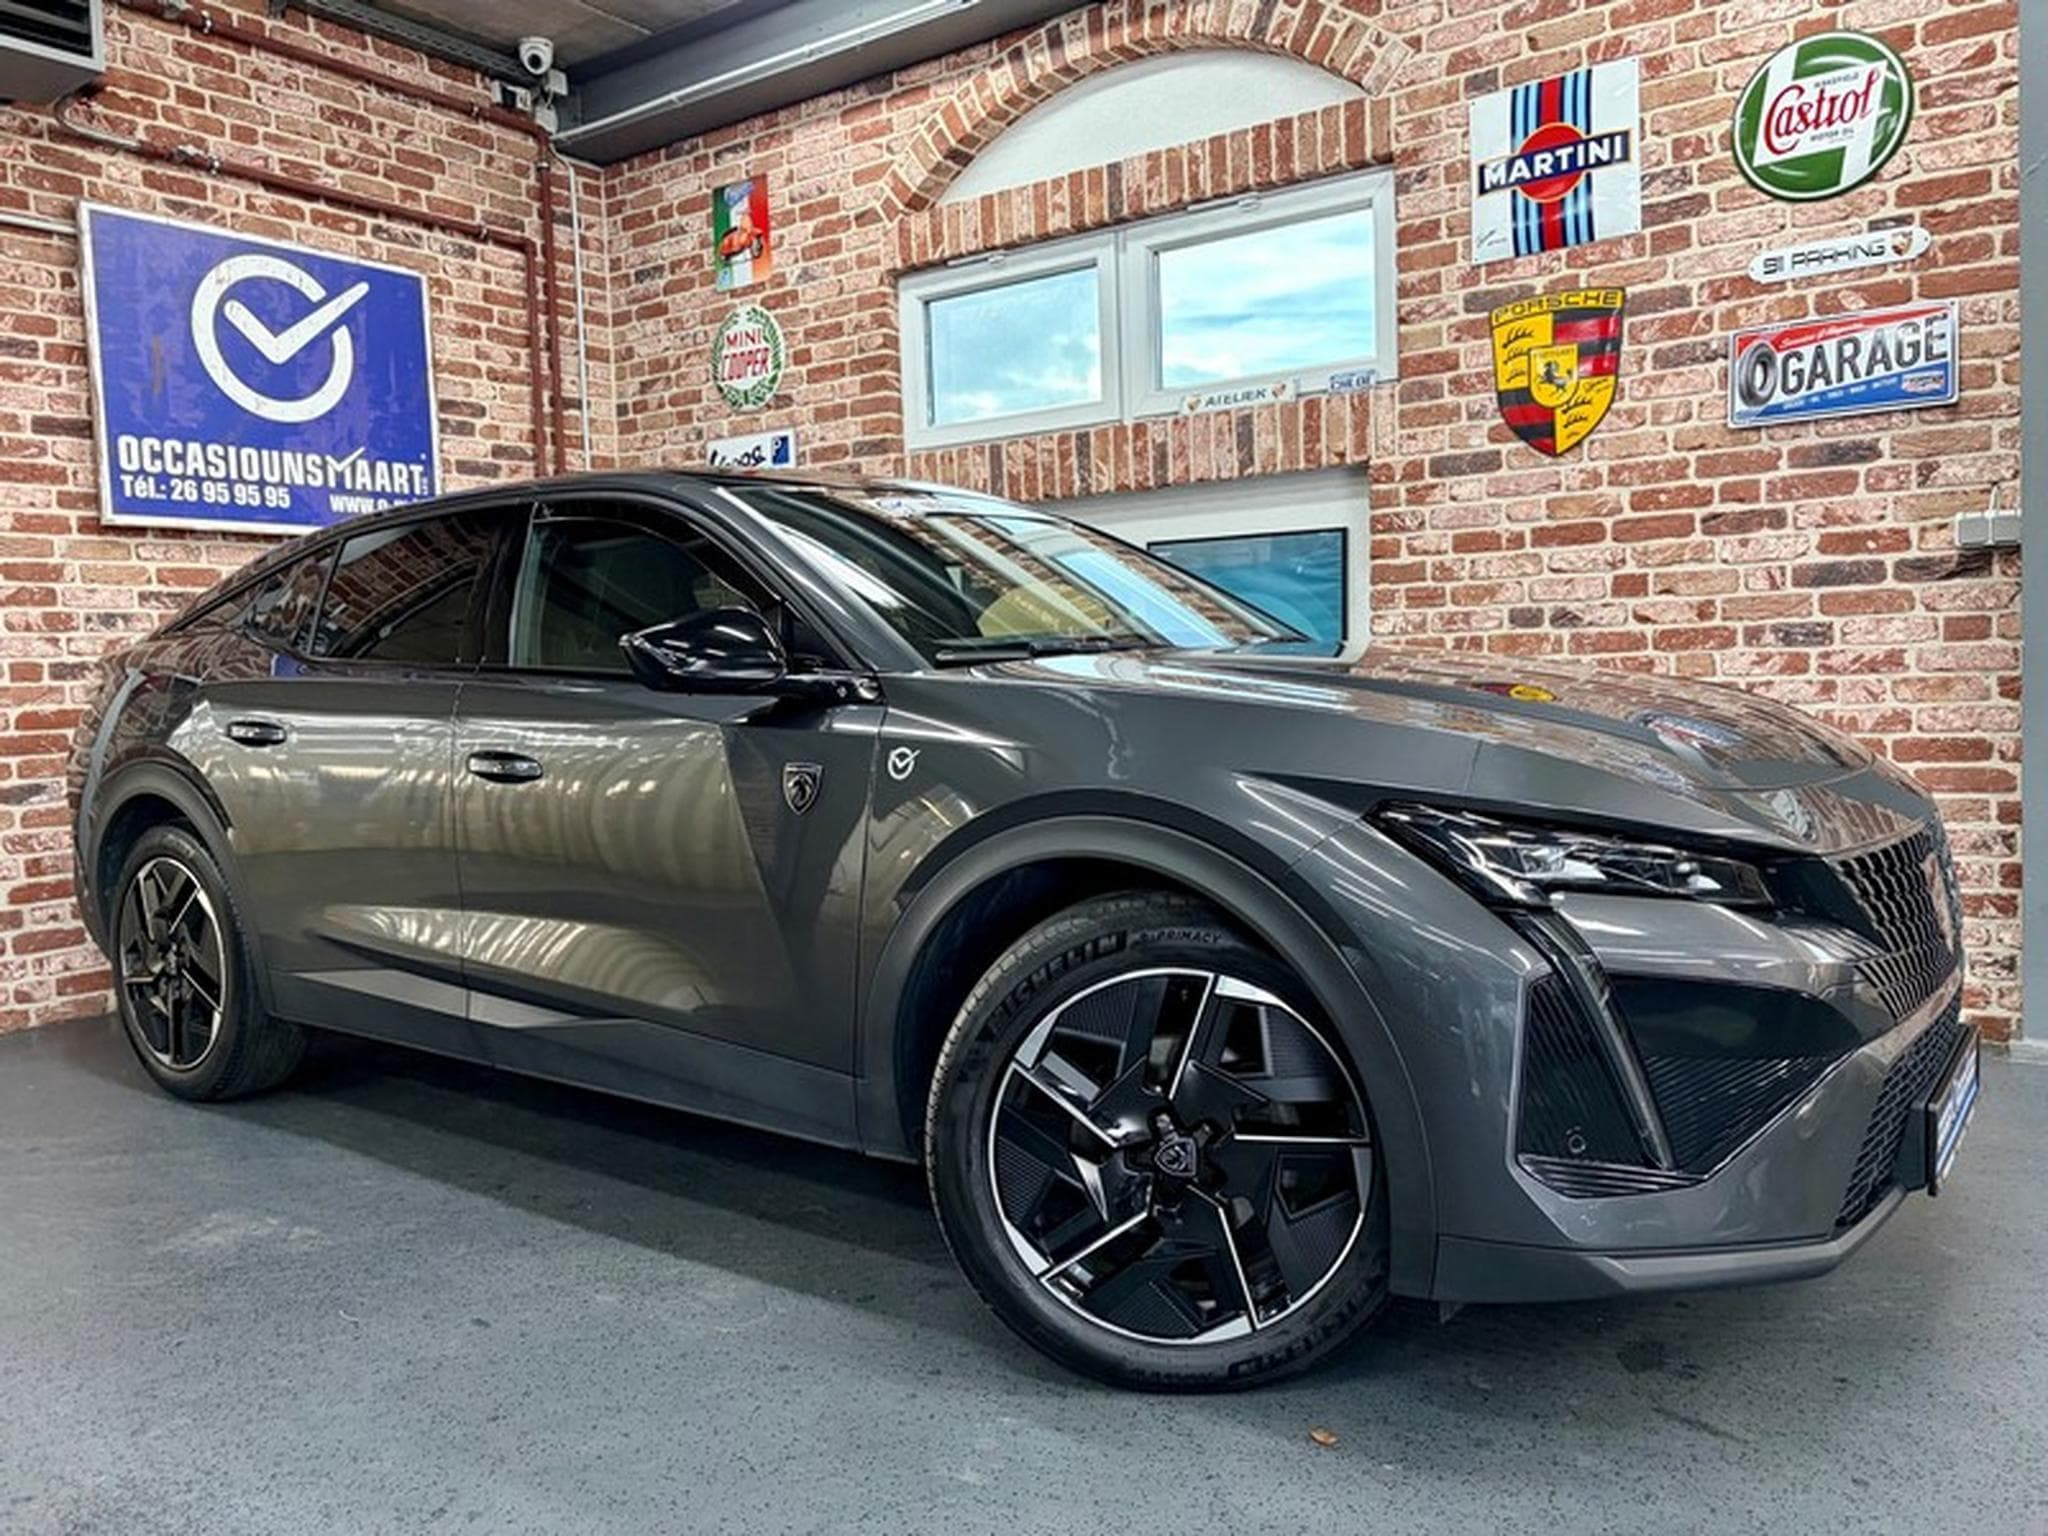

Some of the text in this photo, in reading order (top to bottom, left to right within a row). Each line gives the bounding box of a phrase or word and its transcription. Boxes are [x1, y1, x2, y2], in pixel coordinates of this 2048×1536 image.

[1764, 67, 1881, 156] Castrol
[1483, 134, 1623, 190] MARTINI
[1792, 239, 1886, 270] PARKING
[1494, 291, 1619, 323] PORSCHE
[726, 327, 762, 346] MINI
[722, 347, 770, 381] COOPER
[1780, 312, 1949, 396] GARAGE
[117, 434, 424, 496] OCCASIOUNSMAART
[170, 478, 199, 502] 26
[202, 480, 230, 505] 95
[234, 482, 261, 507] 95
[264, 485, 291, 509] 95
